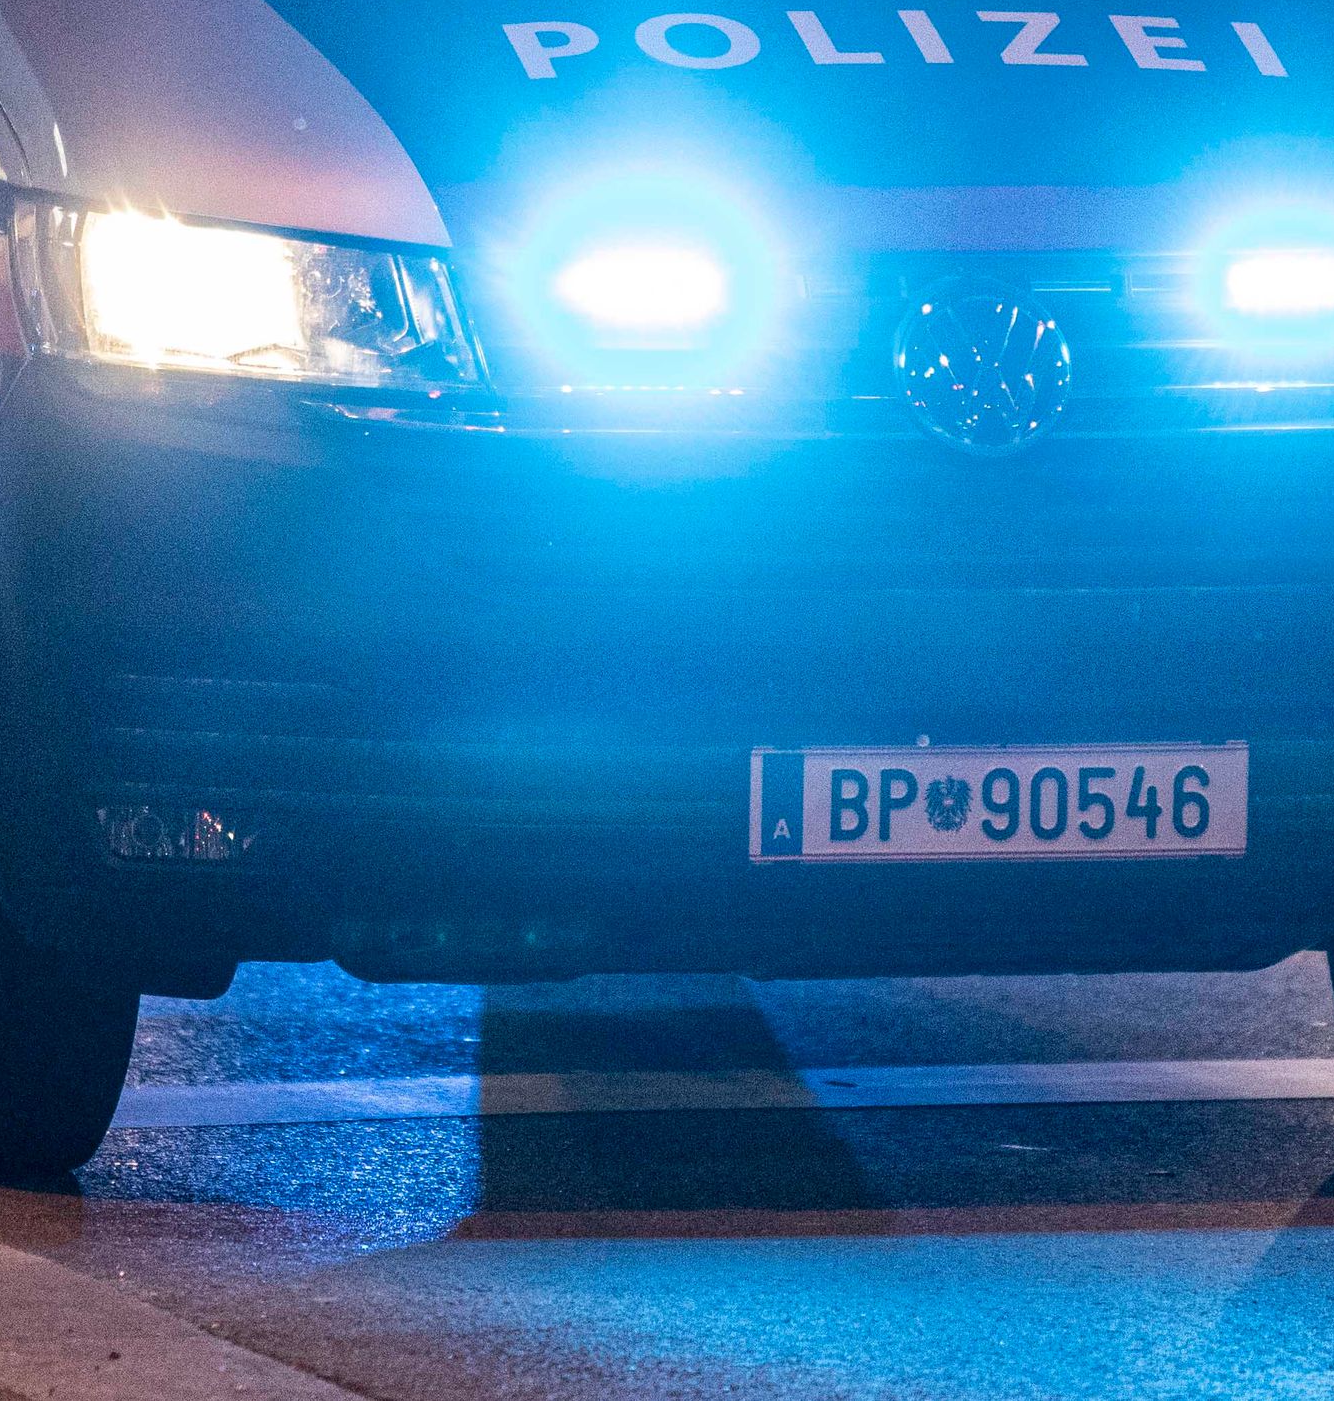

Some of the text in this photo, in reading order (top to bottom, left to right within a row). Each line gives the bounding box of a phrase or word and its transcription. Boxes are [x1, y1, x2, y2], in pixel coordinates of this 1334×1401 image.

[502, 10, 1289, 80] POLIZEI
[772, 818, 792, 840] A
[829, 764, 1211, 843] BP 90546
